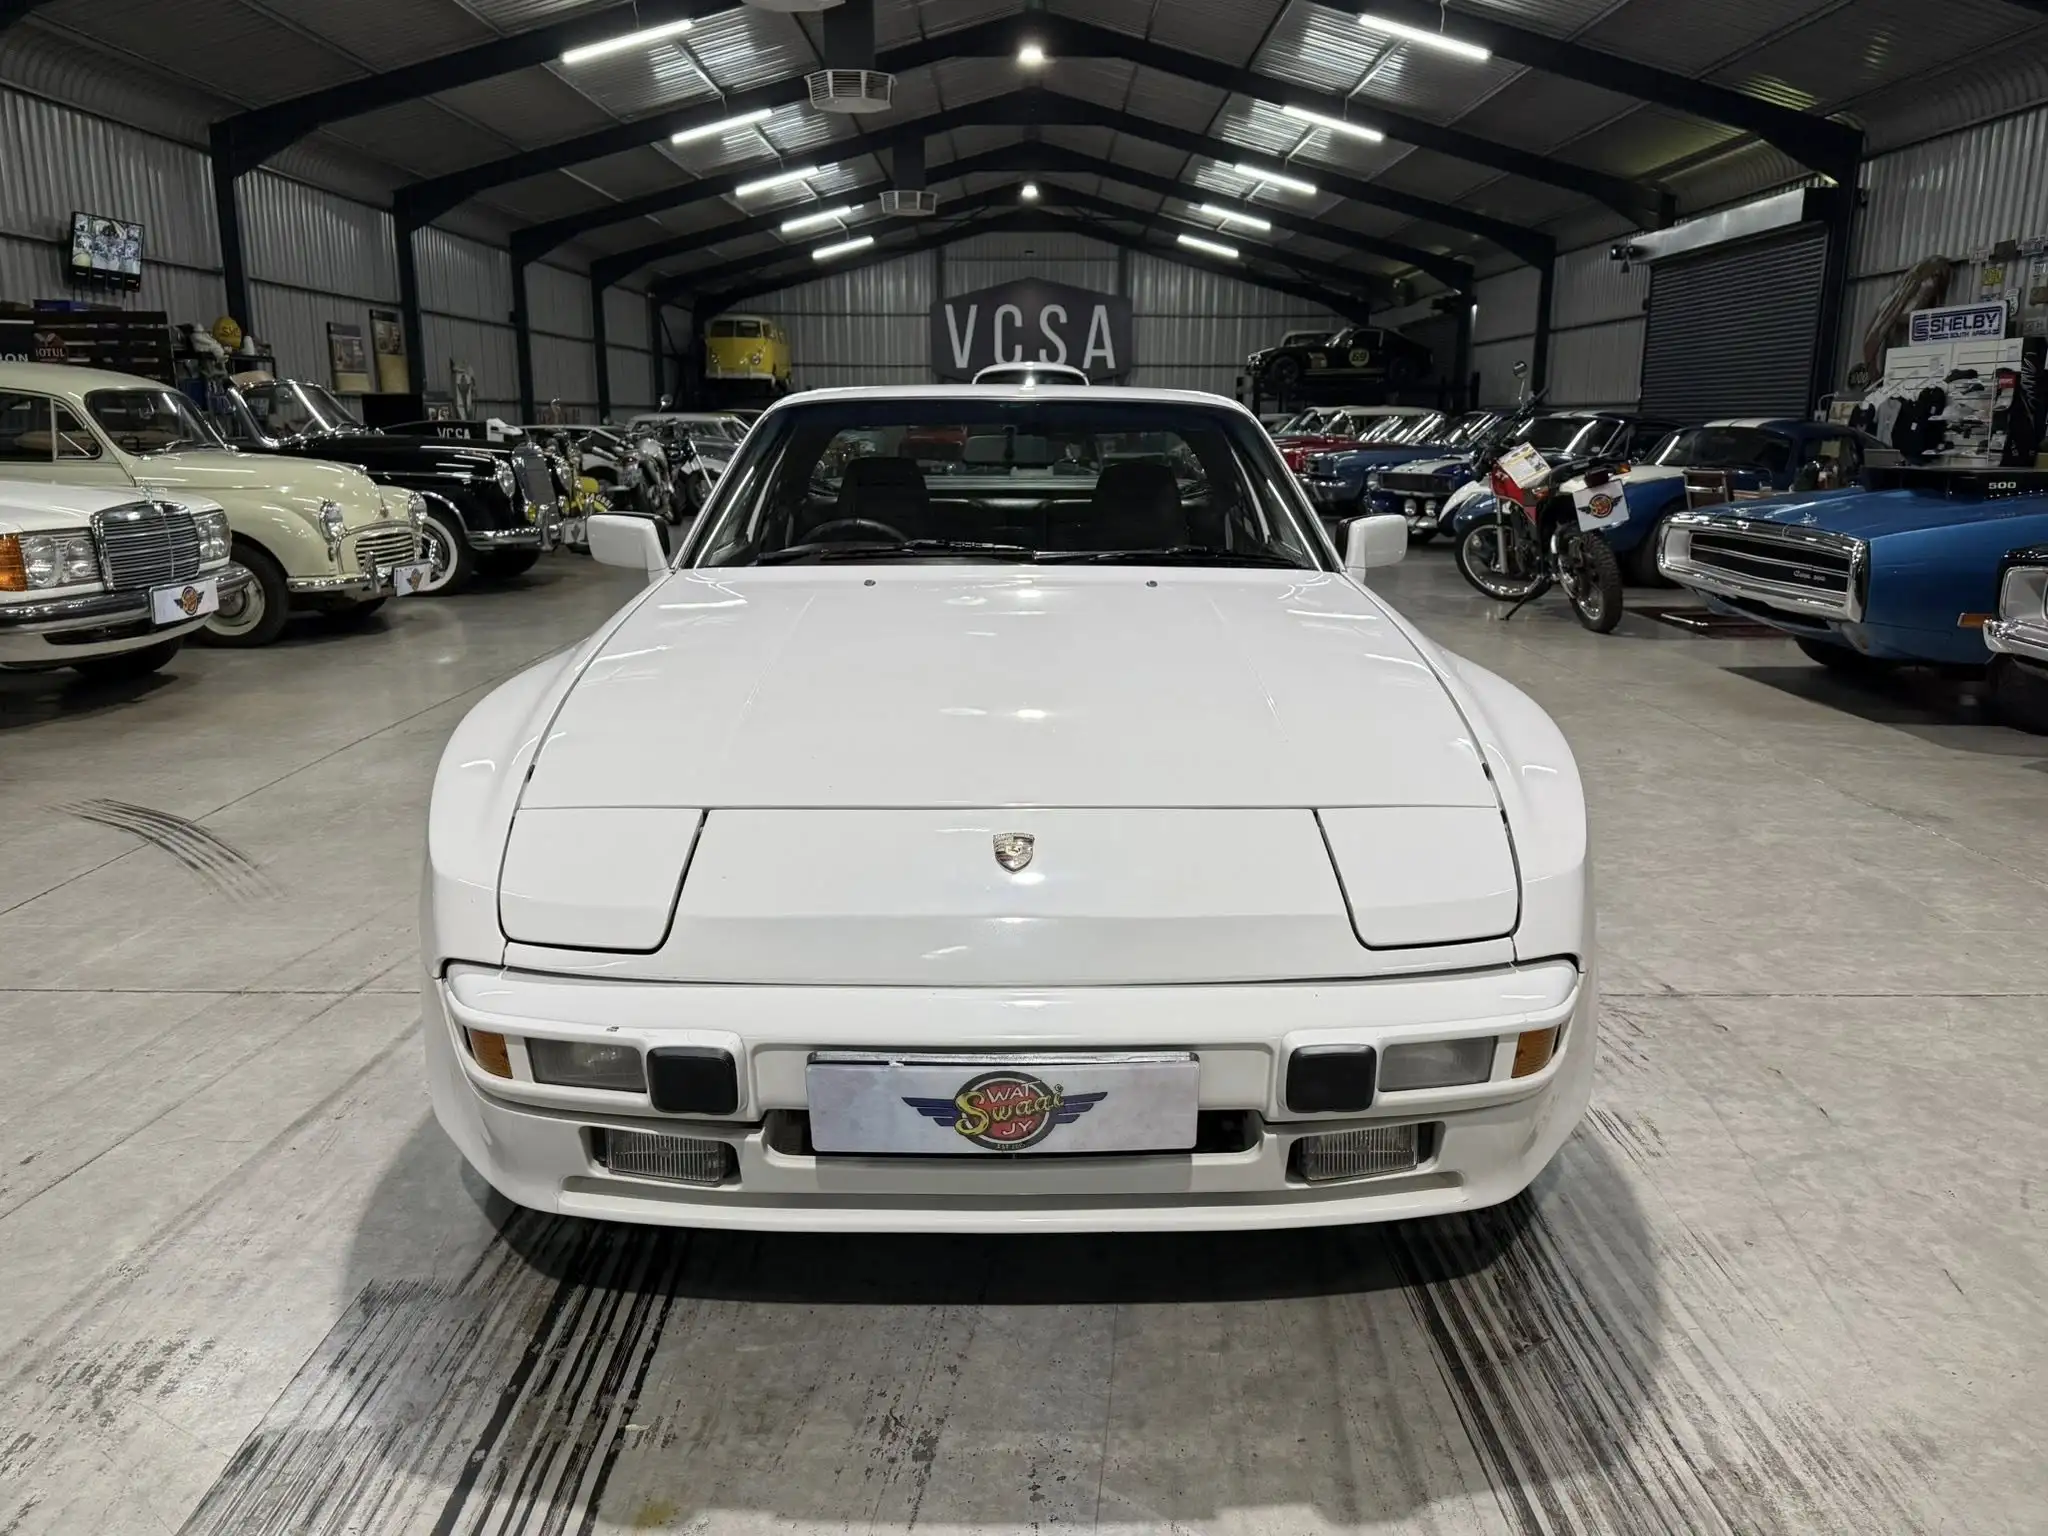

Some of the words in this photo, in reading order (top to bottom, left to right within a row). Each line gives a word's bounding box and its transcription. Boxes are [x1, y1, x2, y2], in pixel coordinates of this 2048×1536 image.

[1930, 313, 1997, 334] SHELBY
[944, 304, 1117, 369] VCSA
[1950, 331, 1971, 339] SOUTH
[1972, 330, 1993, 338] AFRICA
[0, 353, 29, 362] ON
[1988, 481, 2017, 490] 500
[986, 1079, 1041, 1104] WAT
[1002, 1120, 1033, 1136] JY
